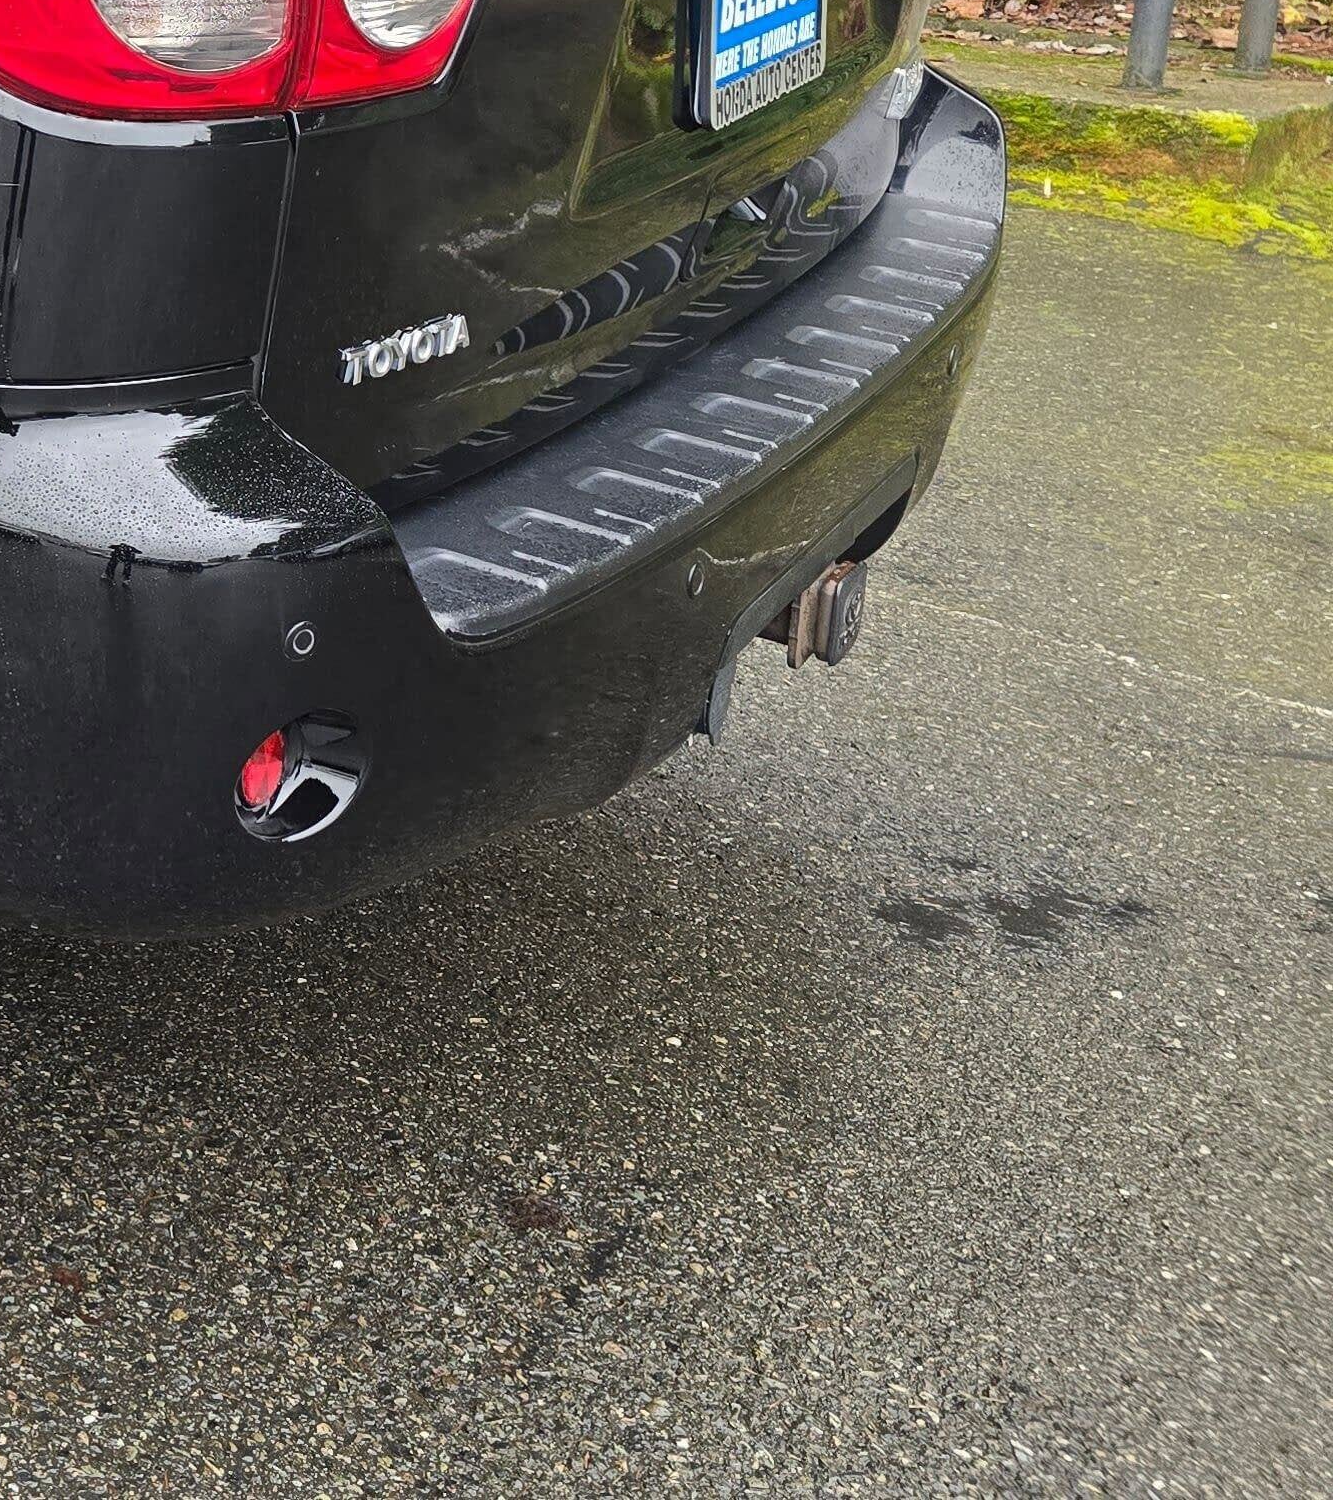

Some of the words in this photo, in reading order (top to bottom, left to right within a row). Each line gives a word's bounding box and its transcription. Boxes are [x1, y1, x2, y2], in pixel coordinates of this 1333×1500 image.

[742, 39, 760, 69] THE
[760, 20, 798, 60] HONDAS
[798, 11, 817, 44] ARE
[716, 77, 755, 128] HONDA
[755, 60, 783, 108] AUTO
[784, 42, 823, 90] CENTER
[336, 313, 471, 387] TOYOTA
